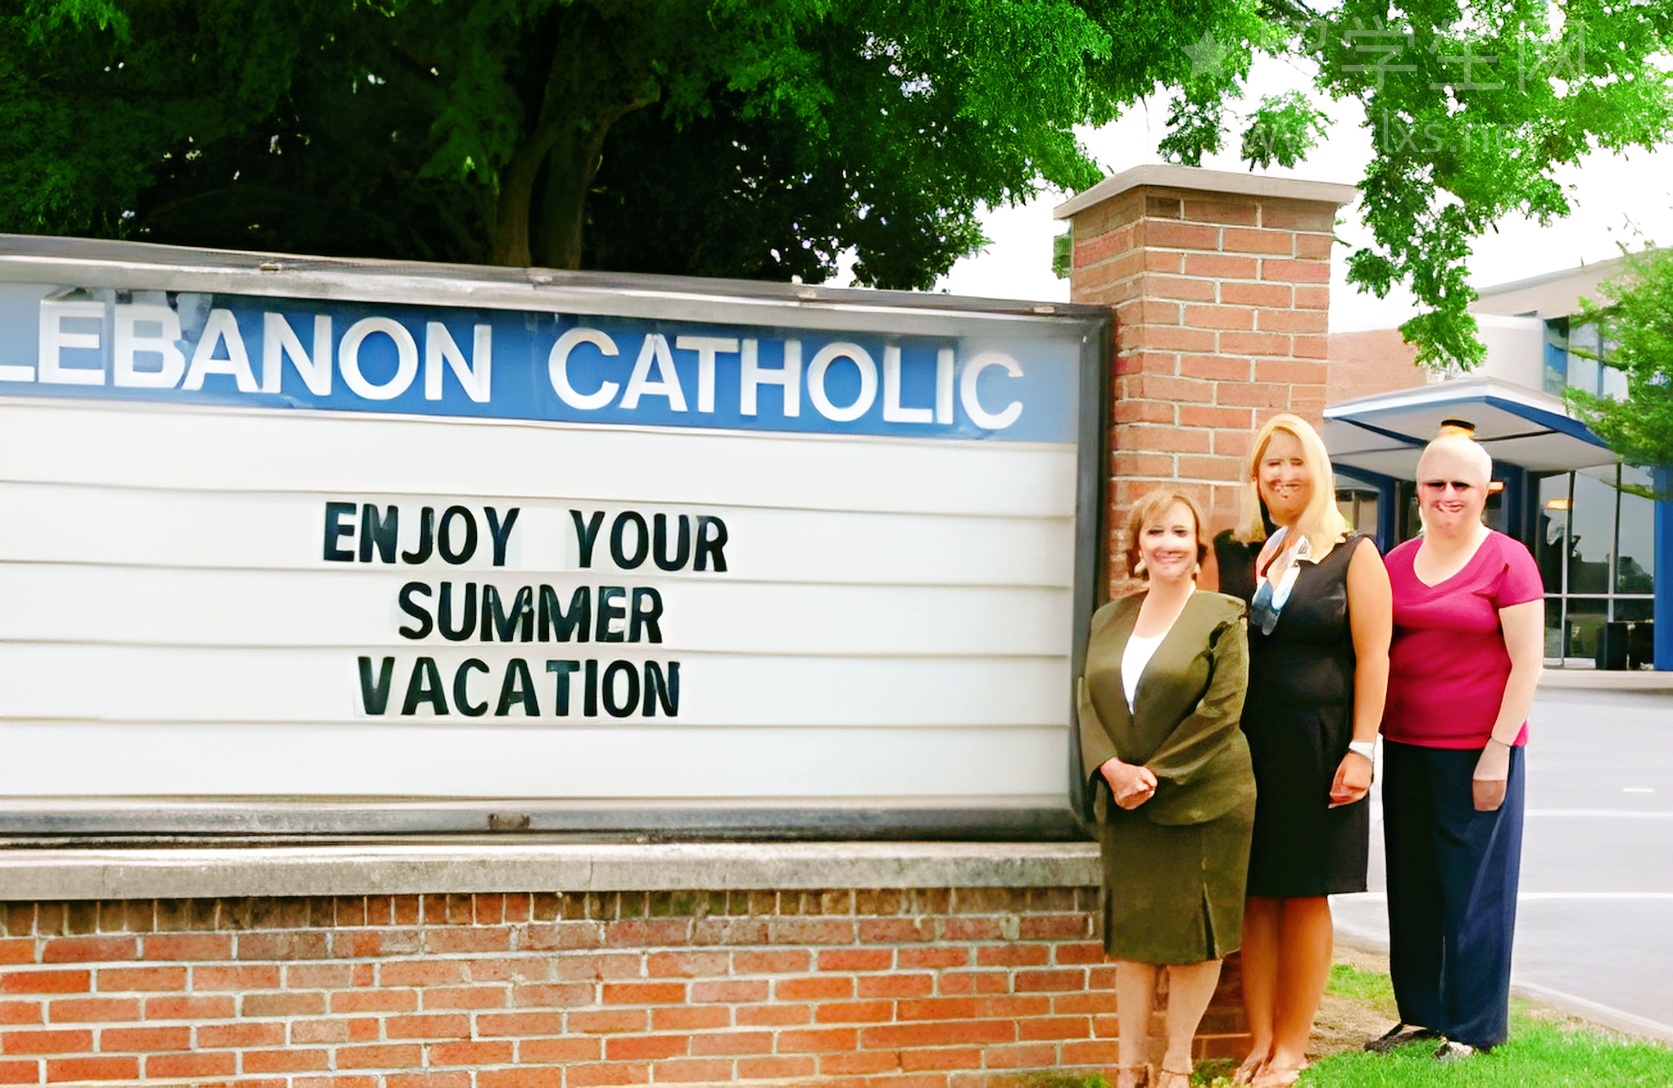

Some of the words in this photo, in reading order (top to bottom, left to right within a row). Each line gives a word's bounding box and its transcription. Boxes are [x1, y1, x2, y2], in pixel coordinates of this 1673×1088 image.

[548, 327, 1024, 430] CATHOLIC
[323, 502, 520, 566] ENJOY
[569, 509, 729, 572] YOUR
[398, 581, 664, 643] SUMMER
[358, 656, 680, 717] VACATION
